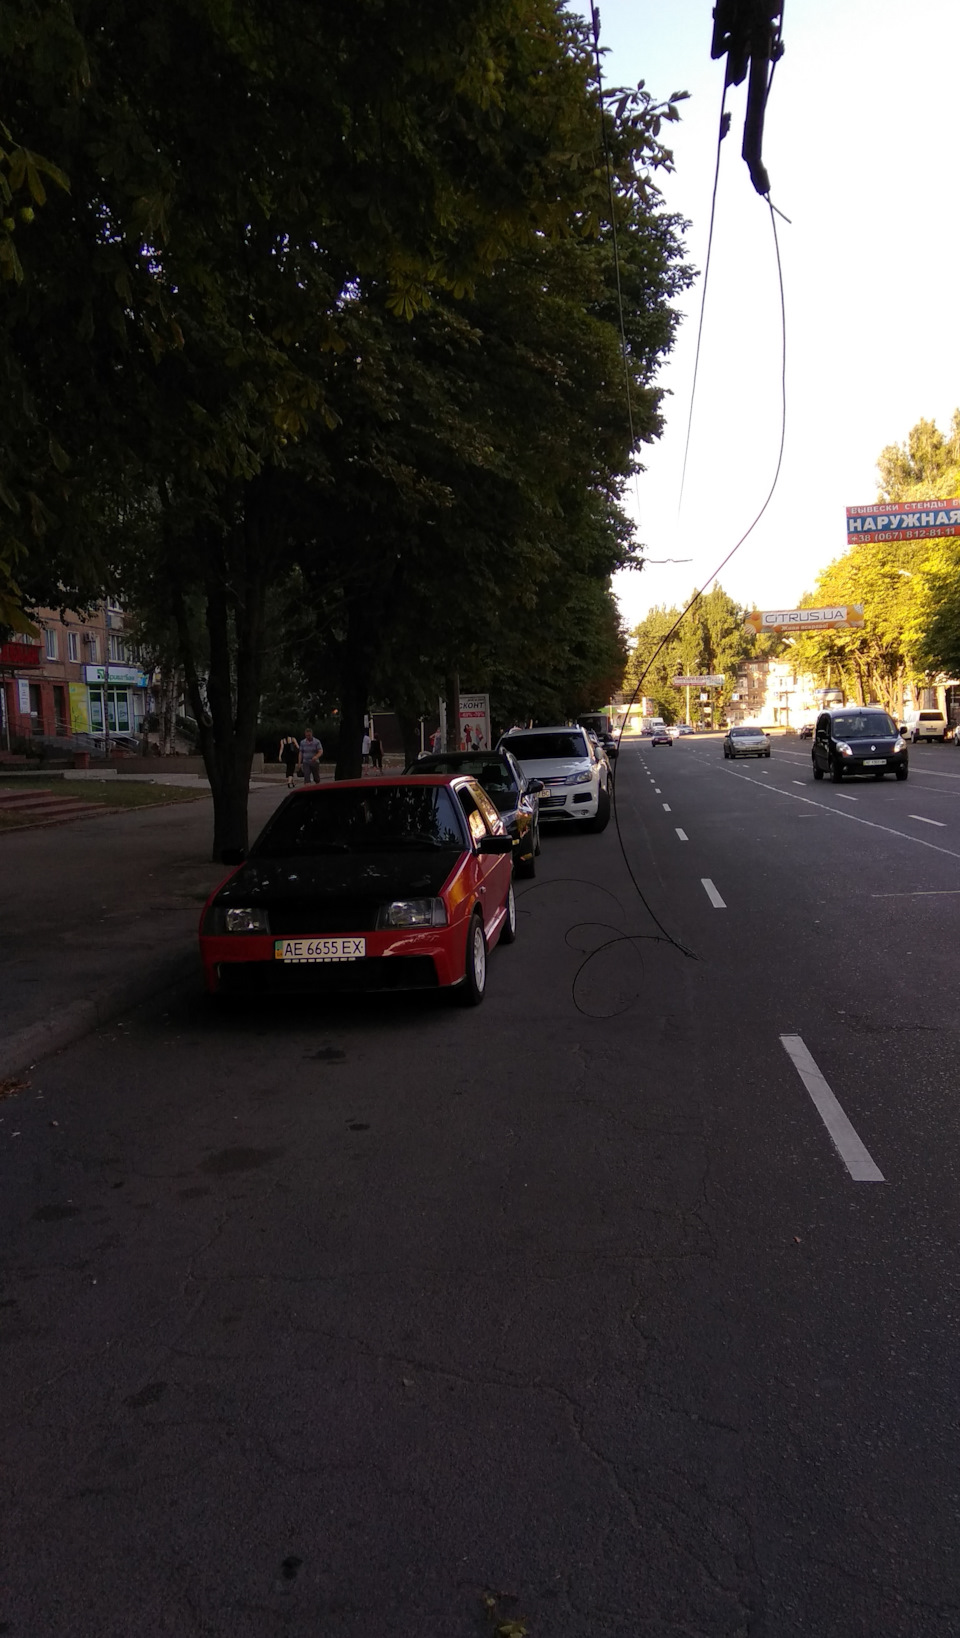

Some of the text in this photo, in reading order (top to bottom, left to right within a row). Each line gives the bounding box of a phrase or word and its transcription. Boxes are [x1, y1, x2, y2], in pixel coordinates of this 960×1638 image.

[851, 505, 899, 514] ВЫВЕСКИ
[904, 501, 947, 510] СТЕНДЫ
[849, 510, 960, 532] НАРУЖНАЯ
[874, 532, 903, 542] (067)
[906, 527, 955, 538] 812-81-11
[284, 940, 362, 956] AE 6655 EX
